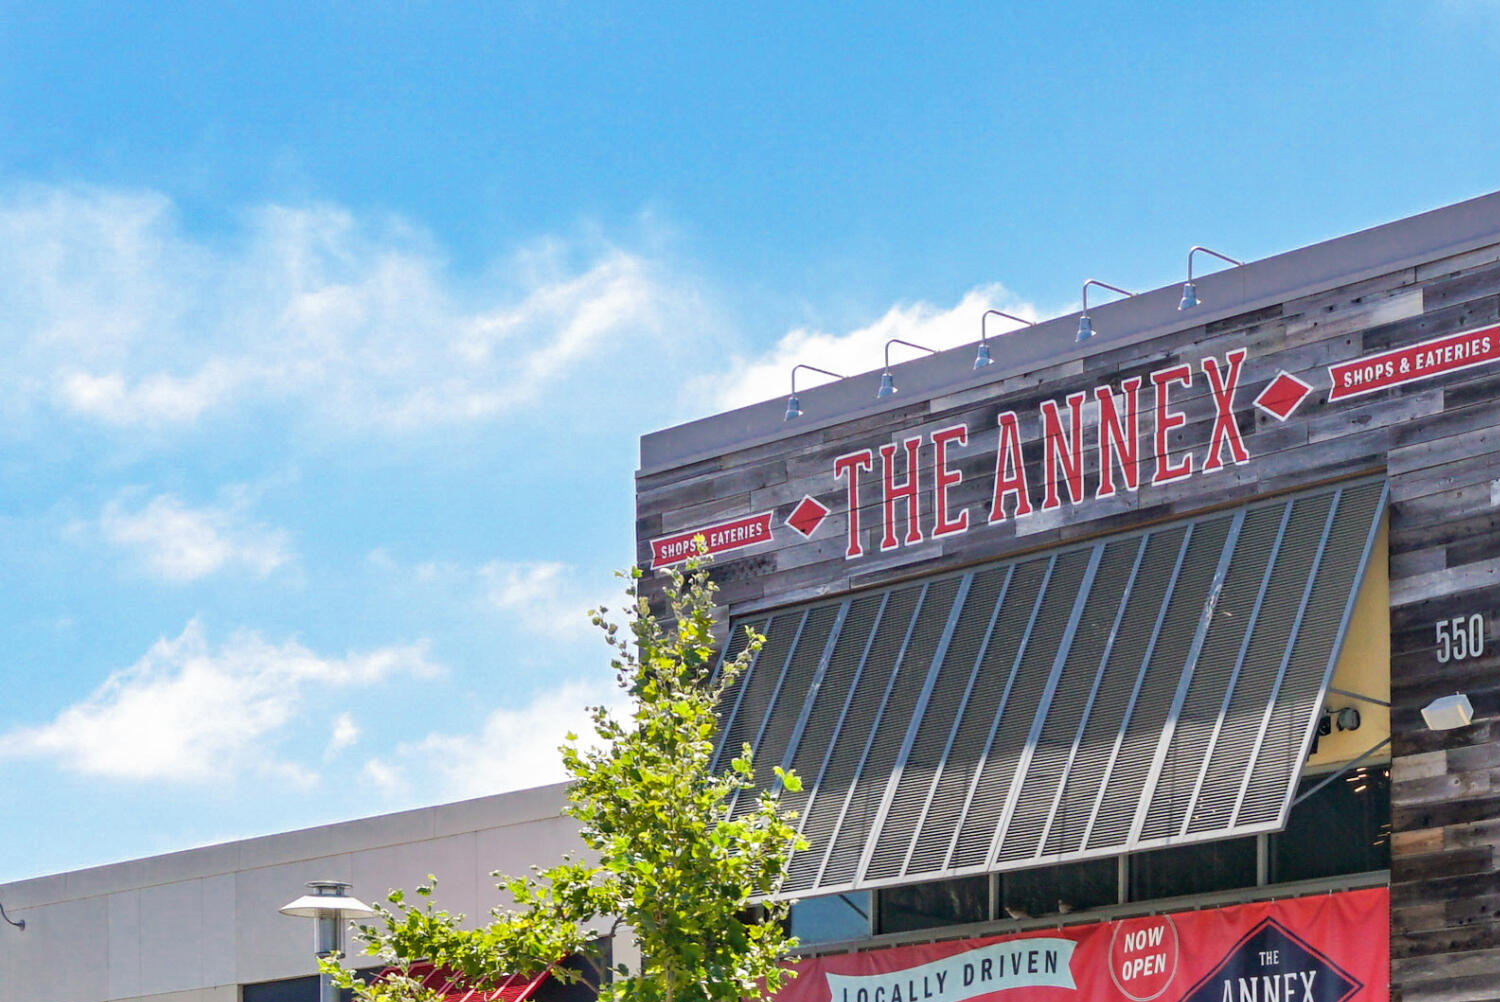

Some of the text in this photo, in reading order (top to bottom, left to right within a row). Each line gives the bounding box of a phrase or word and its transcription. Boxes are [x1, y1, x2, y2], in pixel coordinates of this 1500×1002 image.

[1343, 337, 1491, 388] SHOPS & EATERIES
[834, 347, 1250, 560] THE ANNEX
[661, 538, 697, 559] SHOPS
[710, 522, 763, 547] EATERIES
[1436, 613, 1484, 663] 550
[1124, 926, 1165, 953] NOW
[1259, 950, 1280, 966] THE
[964, 950, 1058, 987] DRIVEN
[1122, 953, 1166, 981] OPEN
